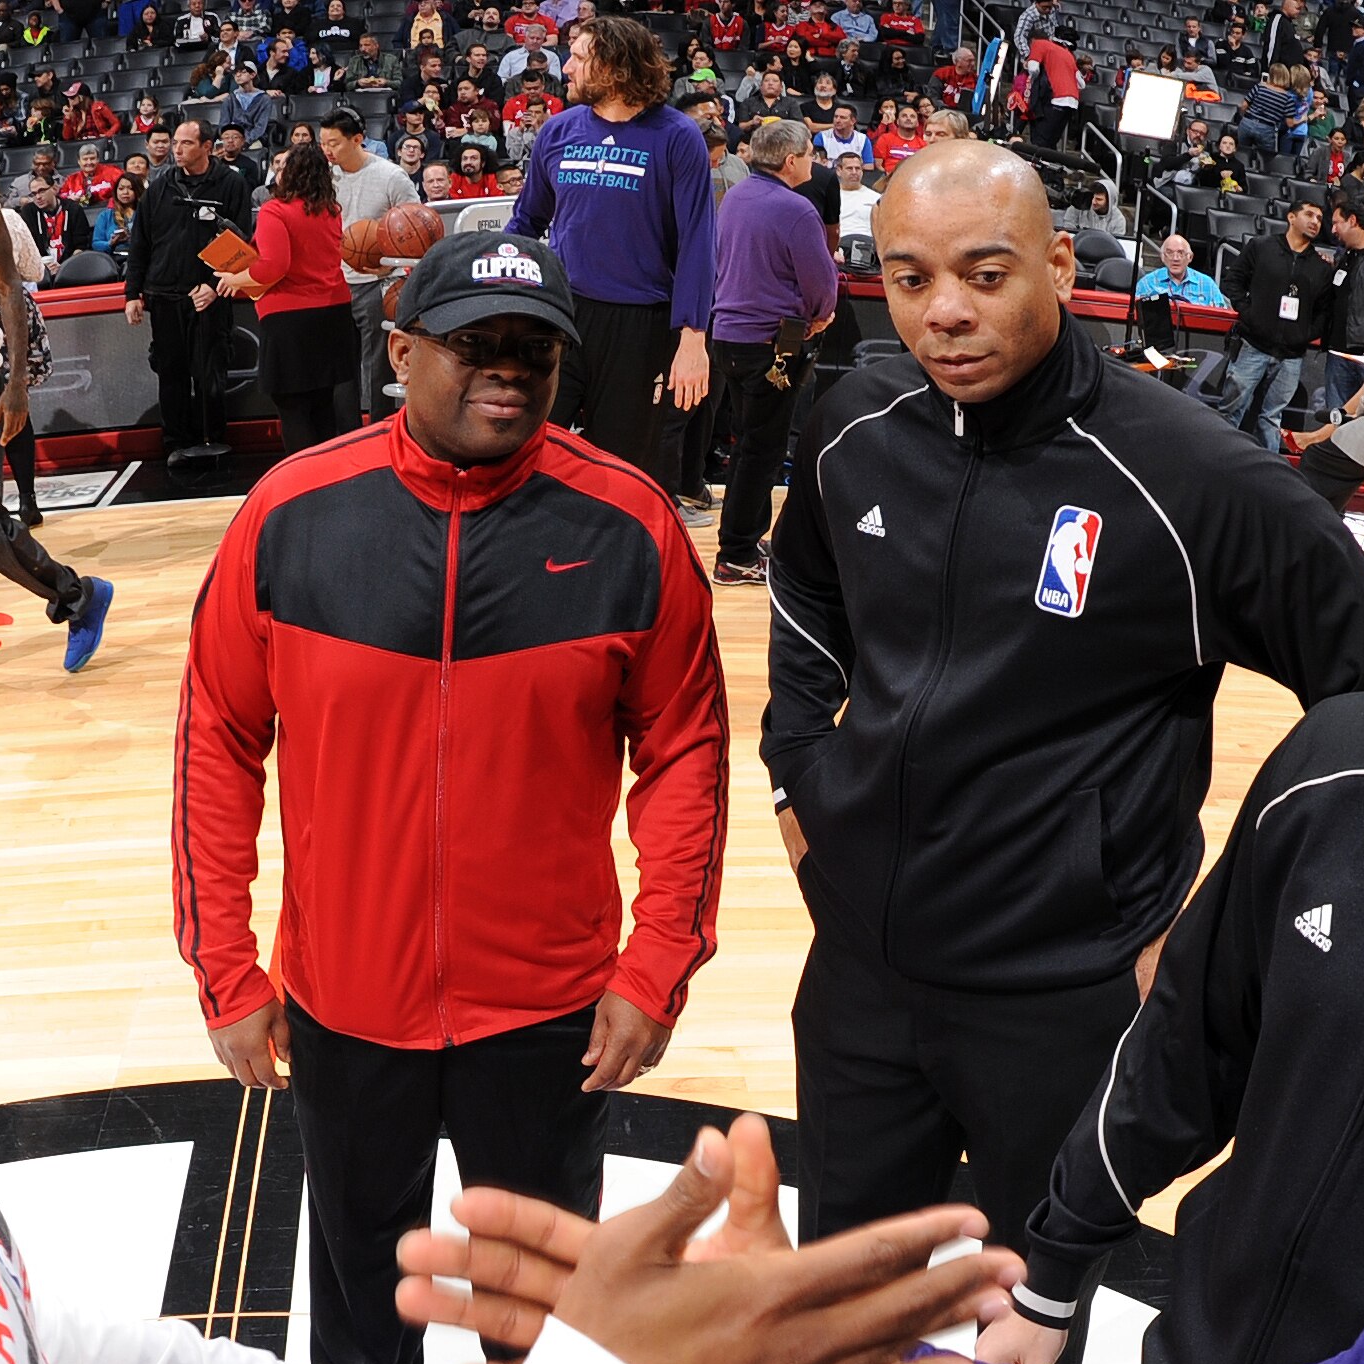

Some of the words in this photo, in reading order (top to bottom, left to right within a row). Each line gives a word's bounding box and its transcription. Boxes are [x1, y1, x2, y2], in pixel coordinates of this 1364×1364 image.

[562, 144, 650, 166] CHARLOTTE
[557, 172, 640, 191] BASKETBALL
[472, 256, 542, 284] CLIPPERS
[856, 520, 886, 538] adidas
[1041, 587, 1069, 609] NBA
[1294, 915, 1333, 953] adidas
